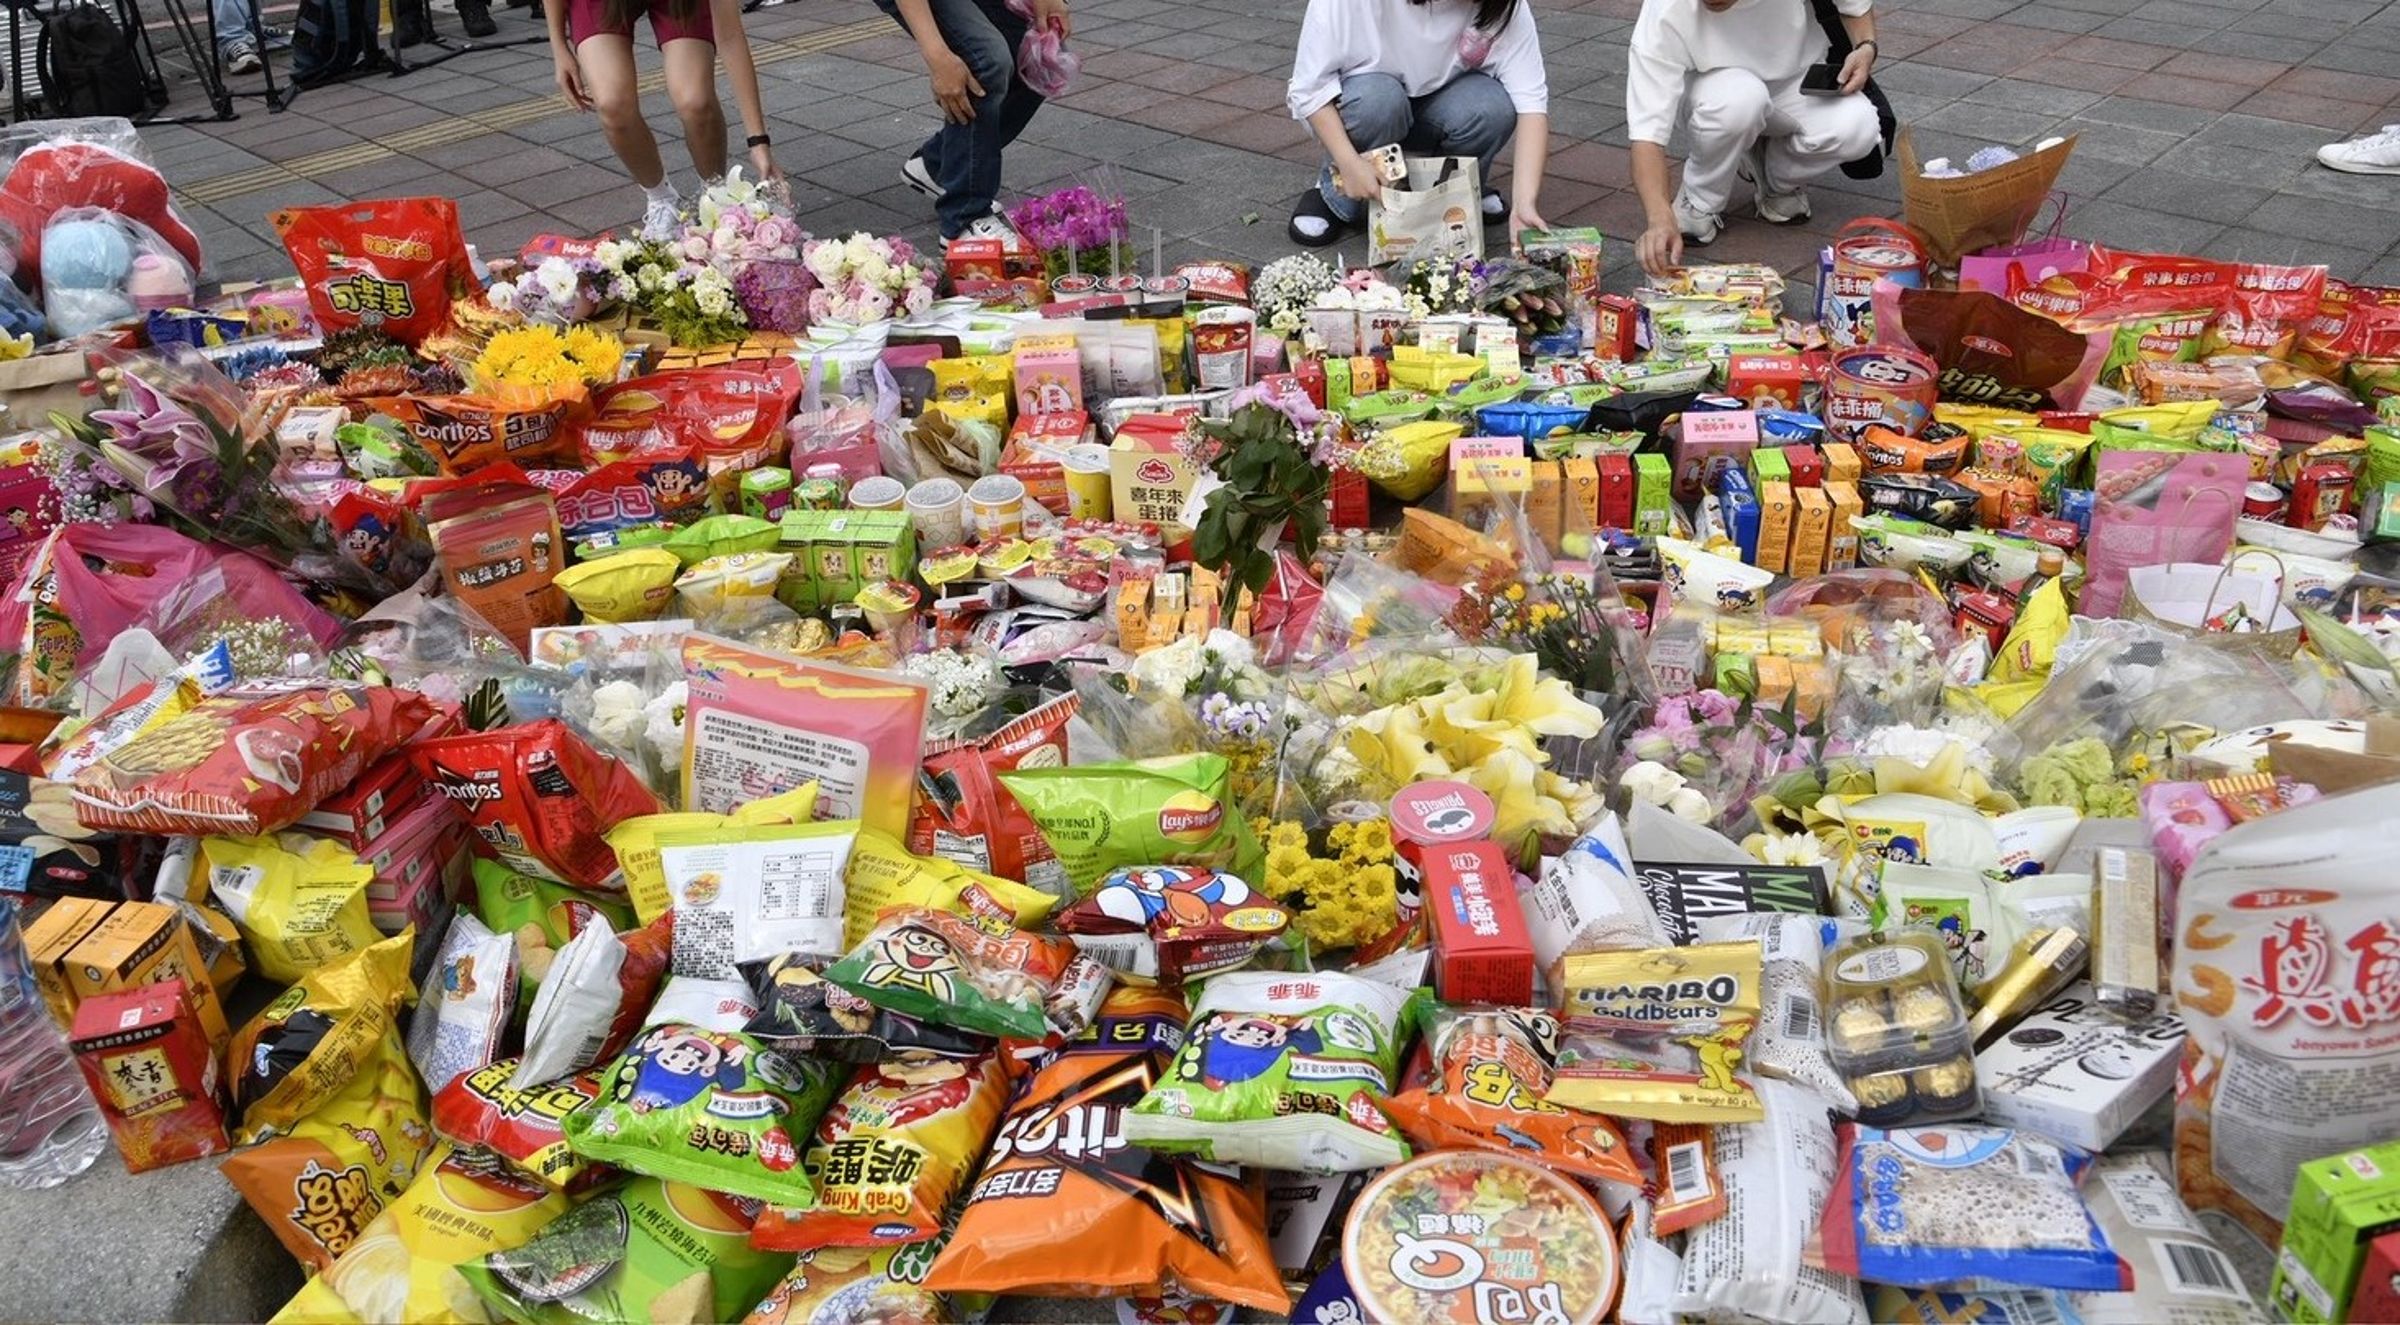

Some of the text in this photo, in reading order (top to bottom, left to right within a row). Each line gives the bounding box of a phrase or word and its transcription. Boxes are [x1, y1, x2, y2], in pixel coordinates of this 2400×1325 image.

[330, 276, 413, 317] 可樂果
[1831, 398, 1884, 421] 乖乖桶
[415, 421, 493, 442] Doritos
[1130, 487, 1185, 505] 喜年來
[1138, 505, 1178, 521] 蛋捲
[434, 781, 502, 800] Doritos
[1410, 790, 1466, 817] PRINGLES
[1162, 811, 1195, 832] Lay's
[1579, 976, 1738, 1005] HARIBO
[1593, 1004, 1719, 1021] Goldbears
[2292, 1036, 2360, 1053] Jenyowe
[987, 1105, 1128, 1170] ritos
[760, 1137, 799, 1163] 乖乖
[804, 1140, 922, 1187] 螃蟹
[822, 1188, 908, 1213] Crab King
[1390, 1231, 1486, 1292] Q
